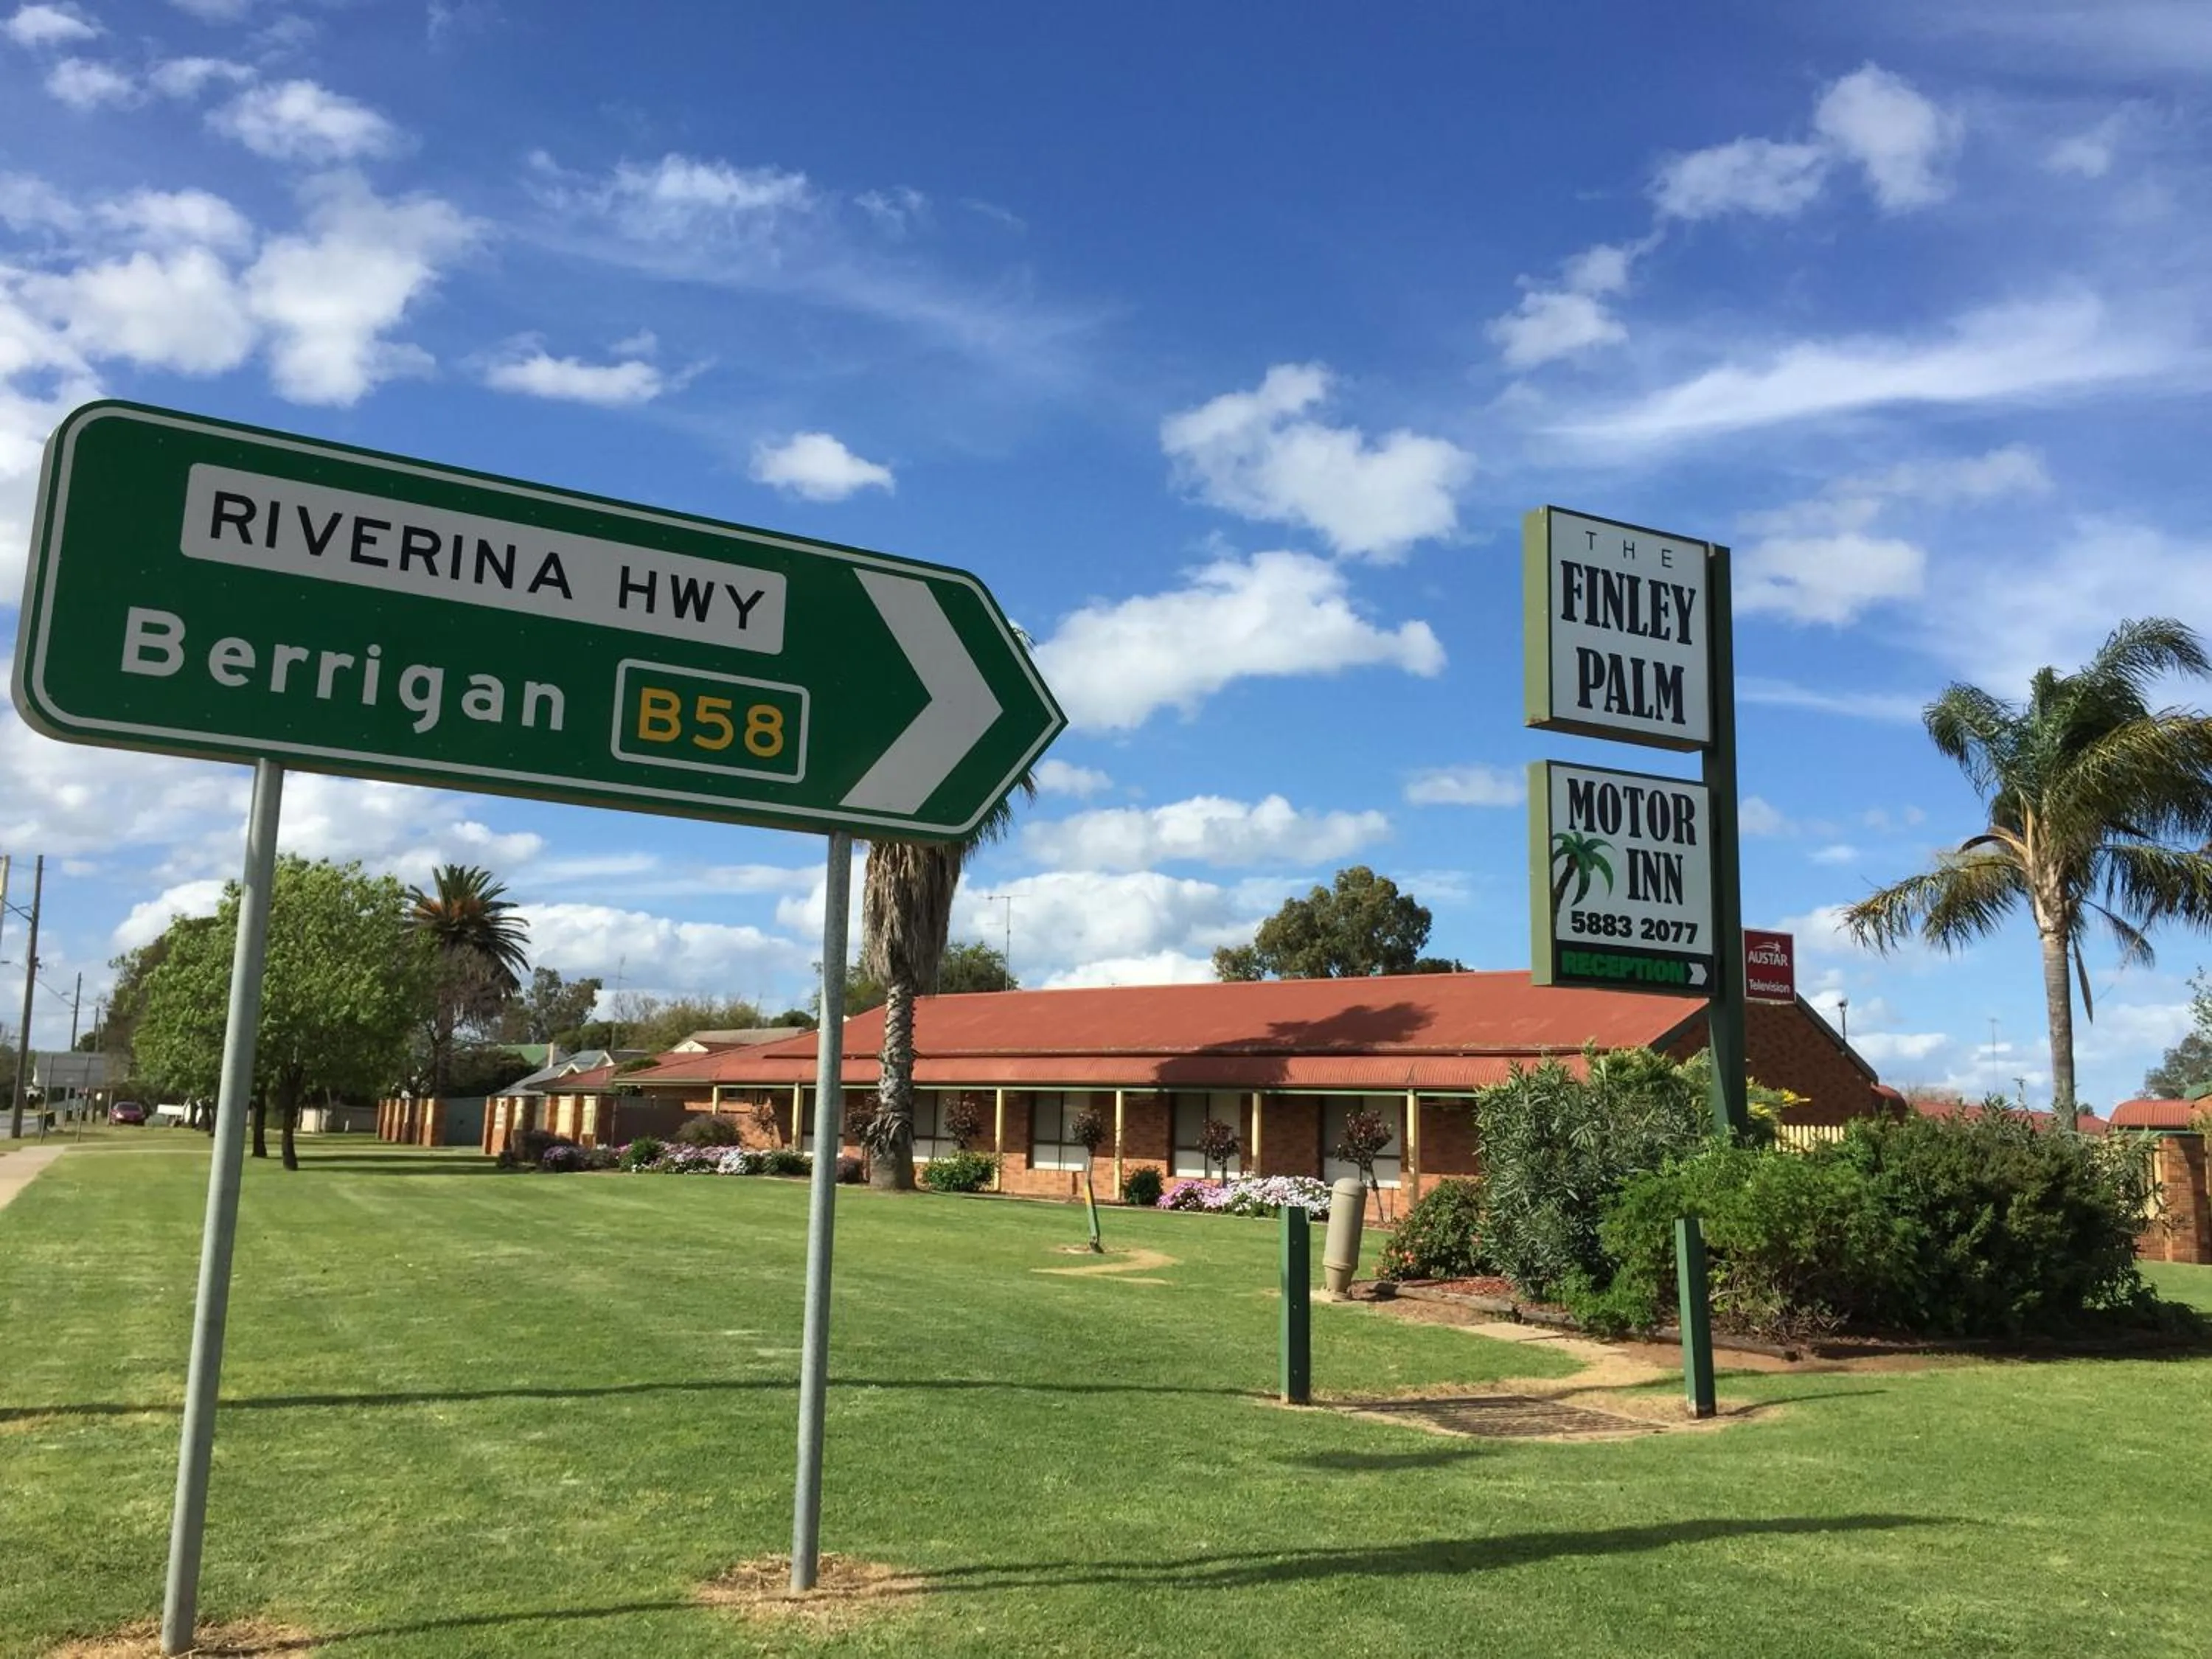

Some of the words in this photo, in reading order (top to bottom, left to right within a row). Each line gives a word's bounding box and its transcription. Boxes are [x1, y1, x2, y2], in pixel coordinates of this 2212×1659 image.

[210, 490, 574, 599] RIVERINA
[618, 565, 765, 630] HWY
[1585, 530, 1673, 568] THE
[1560, 560, 1696, 645] FINLEY
[120, 606, 566, 734] Berrigan
[1576, 646, 1686, 725] PALM
[638, 686, 785, 759] B58
[1567, 778, 1697, 845] MOTOR
[1626, 848, 1683, 905] INN
[1571, 911, 1632, 939] 5883
[1640, 917, 1698, 945] 2077
[1747, 950, 1789, 967] AUSTAR
[1561, 950, 1686, 983] RECEPTION
[1748, 978, 1791, 994] Television
